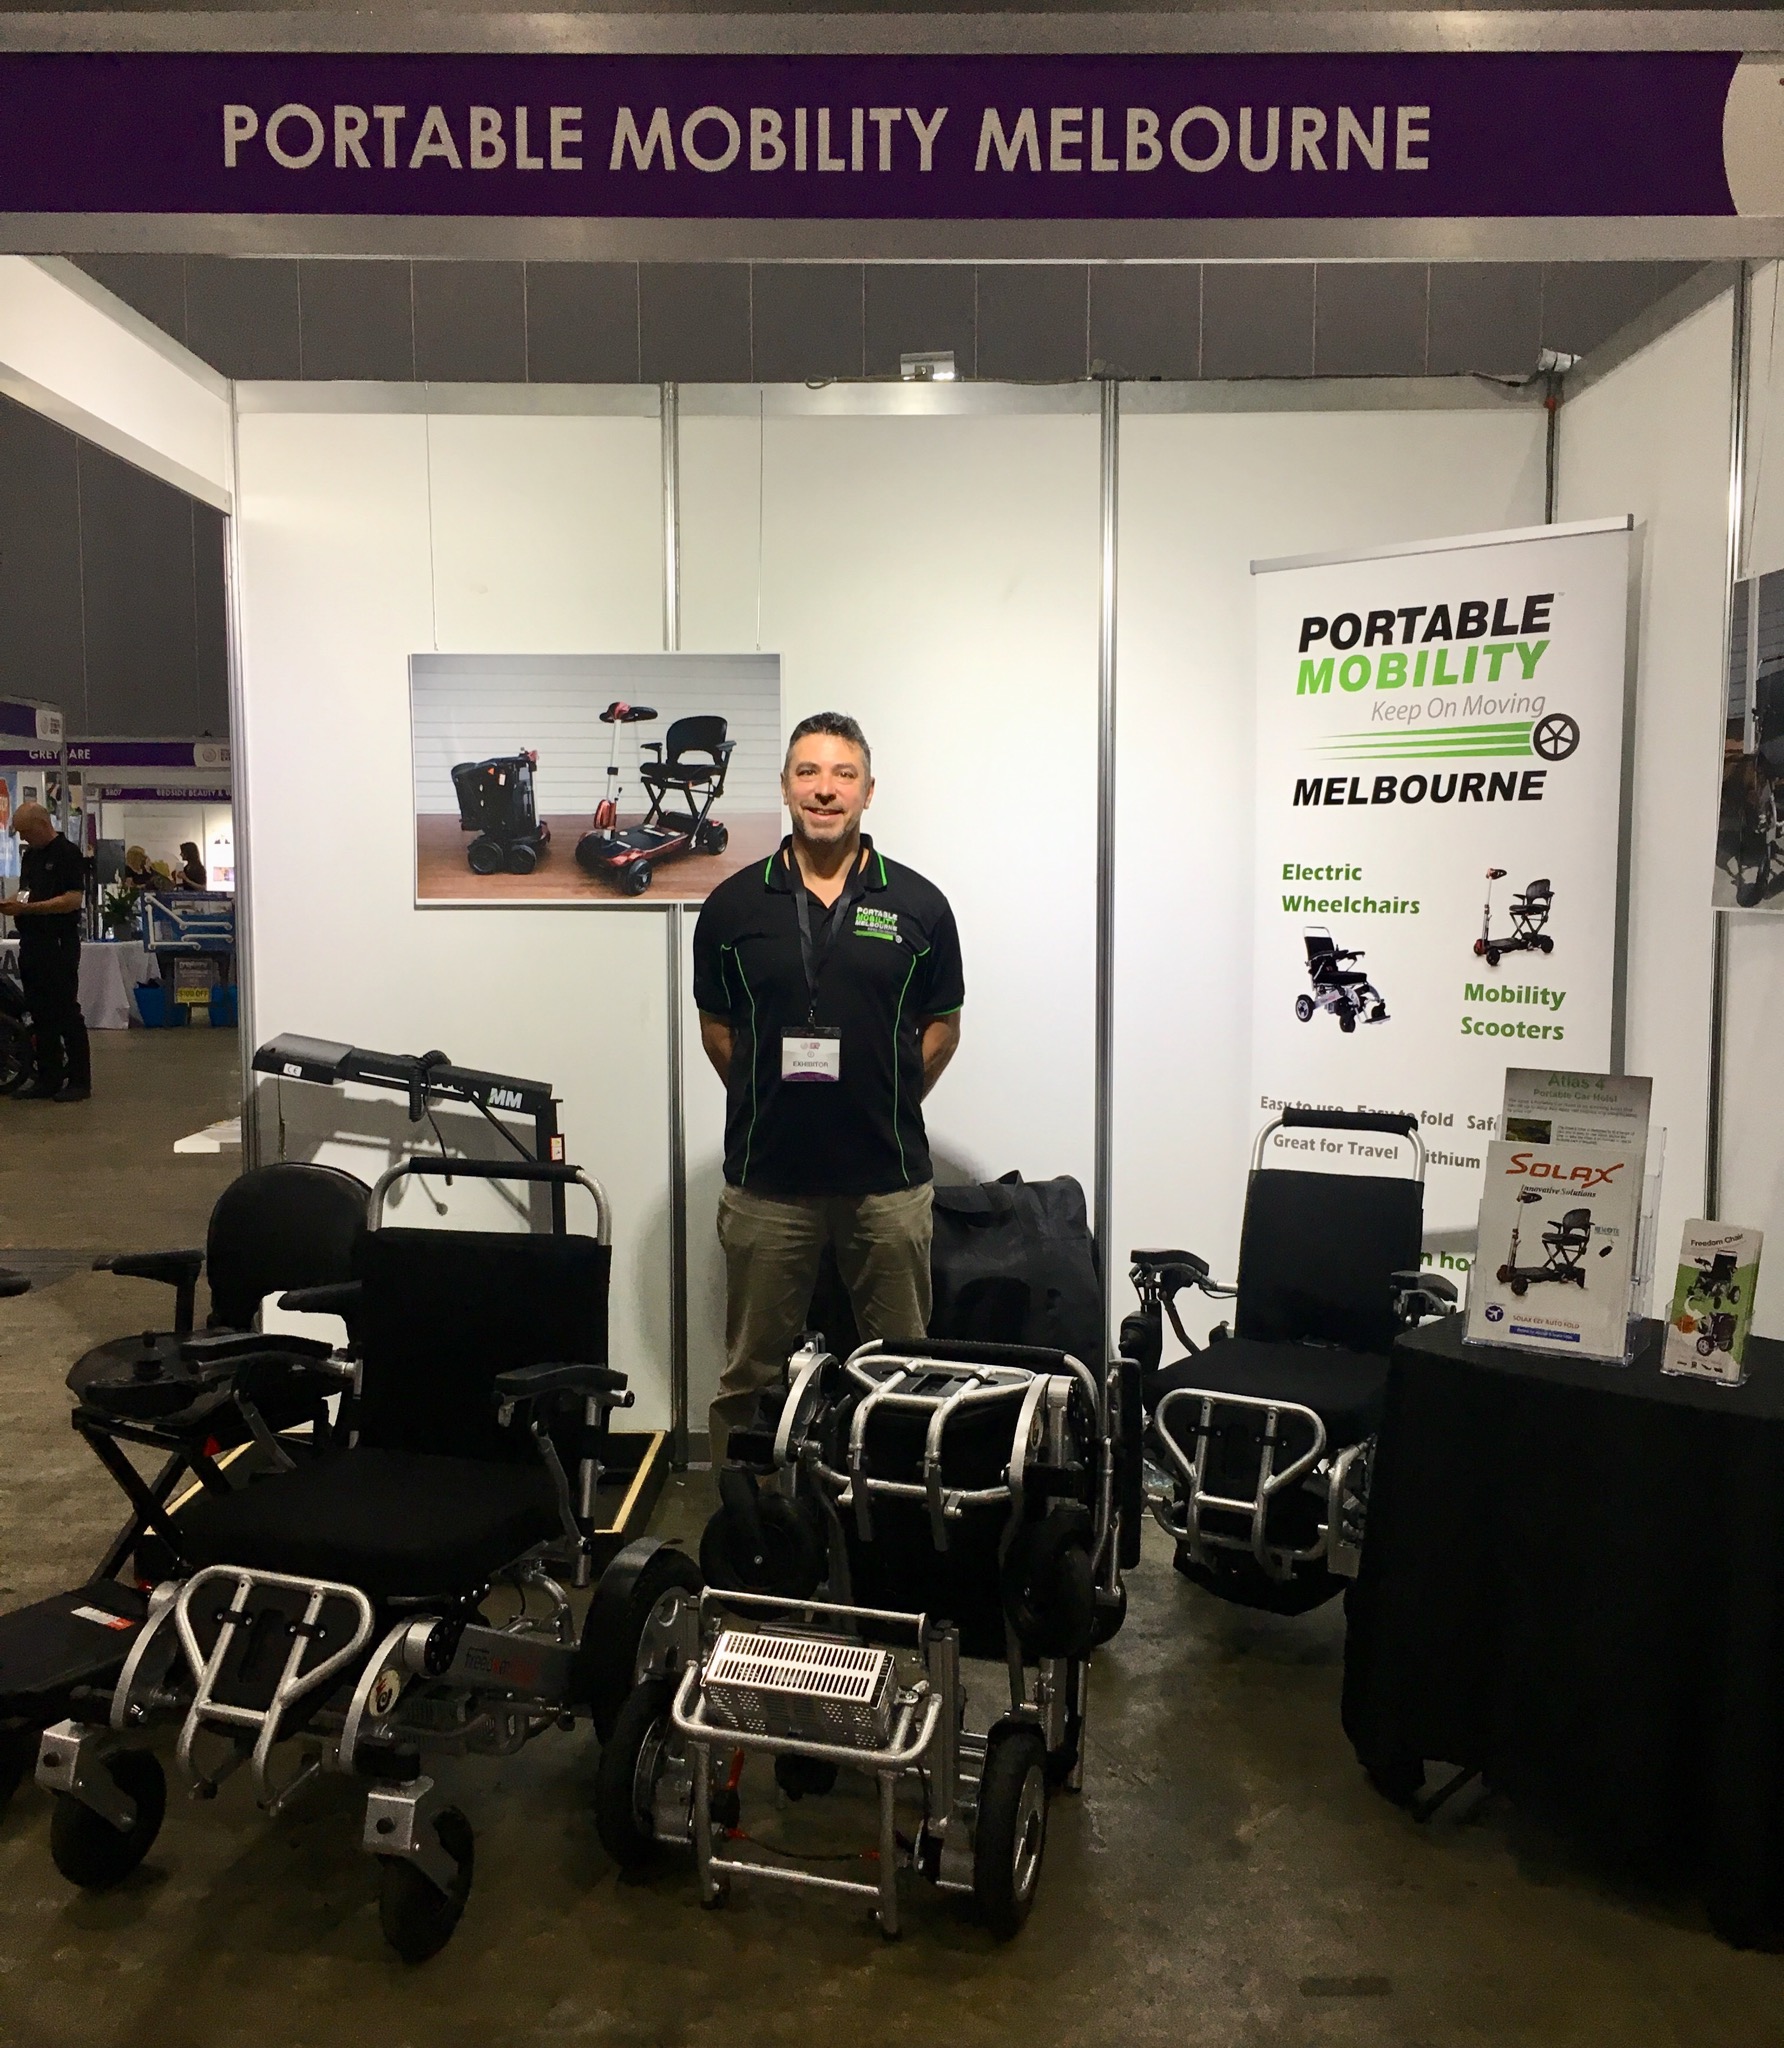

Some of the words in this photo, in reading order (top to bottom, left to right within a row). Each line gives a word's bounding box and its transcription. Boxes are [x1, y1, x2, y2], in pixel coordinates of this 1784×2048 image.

[222, 104, 583, 171] PORTABLE
[609, 106, 948, 173] MOBILITY
[974, 106, 1430, 172] MELBOURNE
[1298, 593, 1555, 653] PORTABLE
[1296, 640, 1551, 695] MOBILITY
[1371, 700, 1421, 725] Keep
[1427, 697, 1457, 719] On
[1462, 693, 1546, 718] Moving
[29, 749, 58, 760] GREY
[69, 749, 91, 760] ARE
[1293, 770, 1547, 806] MELBOURNE
[1282, 863, 1362, 881] Electric
[857, 907, 898, 920] PORTABLE
[1282, 895, 1420, 914] Wheelchairs
[855, 920, 898, 931] MELBOURNE
[856, 914, 897, 926] MOBILITY
[1464, 983, 1566, 1011] Mobility
[1461, 1016, 1565, 1040] Scooters
[1548, 1073, 1590, 1089] Atlas
[1595, 1077, 1605, 1091] 4
[488, 1087, 523, 1109] MM
[1533, 1088, 1572, 1100] Portable
[1574, 1092, 1590, 1101] Car
[1593, 1094, 1618, 1103] Hoist
[1420, 1110, 1454, 1127] fold
[1466, 1115, 1498, 1131] Saf
[1273, 1134, 1316, 1151] Great
[1320, 1138, 1344, 1153] for
[1347, 1141, 1399, 1160] Travel
[1424, 1149, 1481, 1169] ithium
[1506, 1153, 1625, 1189] SOLAX
[1521, 1184, 1560, 1196] Innovative
[1561, 1187, 1596, 1198] Solutions
[1691, 1239, 1724, 1247] Freedom
[1724, 1233, 1744, 1244] Chair
[1440, 1250, 1470, 1271] ho
[1545, 1319, 1562, 1327] AUTO
[1563, 1321, 1580, 1329] FOLD
